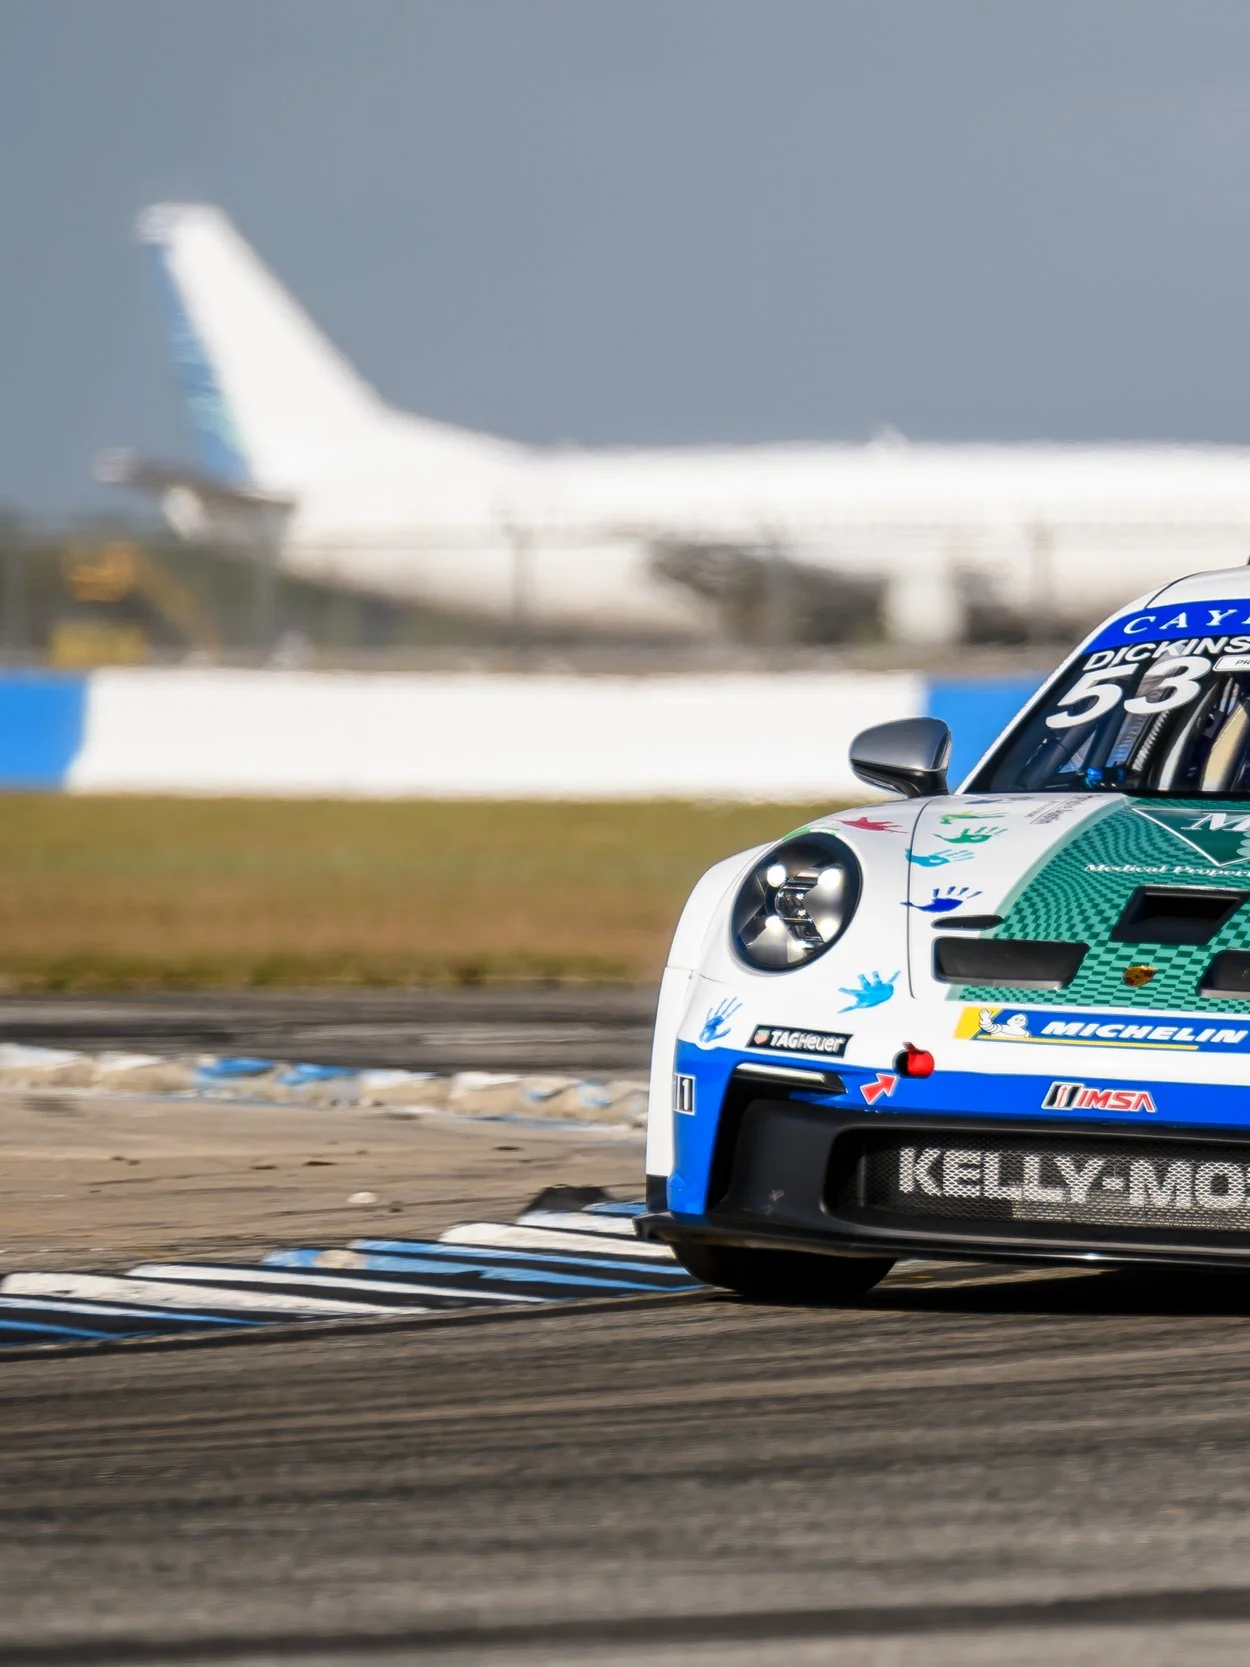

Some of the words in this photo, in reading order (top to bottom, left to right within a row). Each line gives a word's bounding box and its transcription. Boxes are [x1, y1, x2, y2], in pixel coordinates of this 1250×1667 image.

[1045, 656, 1212, 729] 53
[1084, 863, 1168, 875] Medical
[1041, 1020, 1249, 1045] MICHELIN
[1077, 1089, 1155, 1112] IMSA
